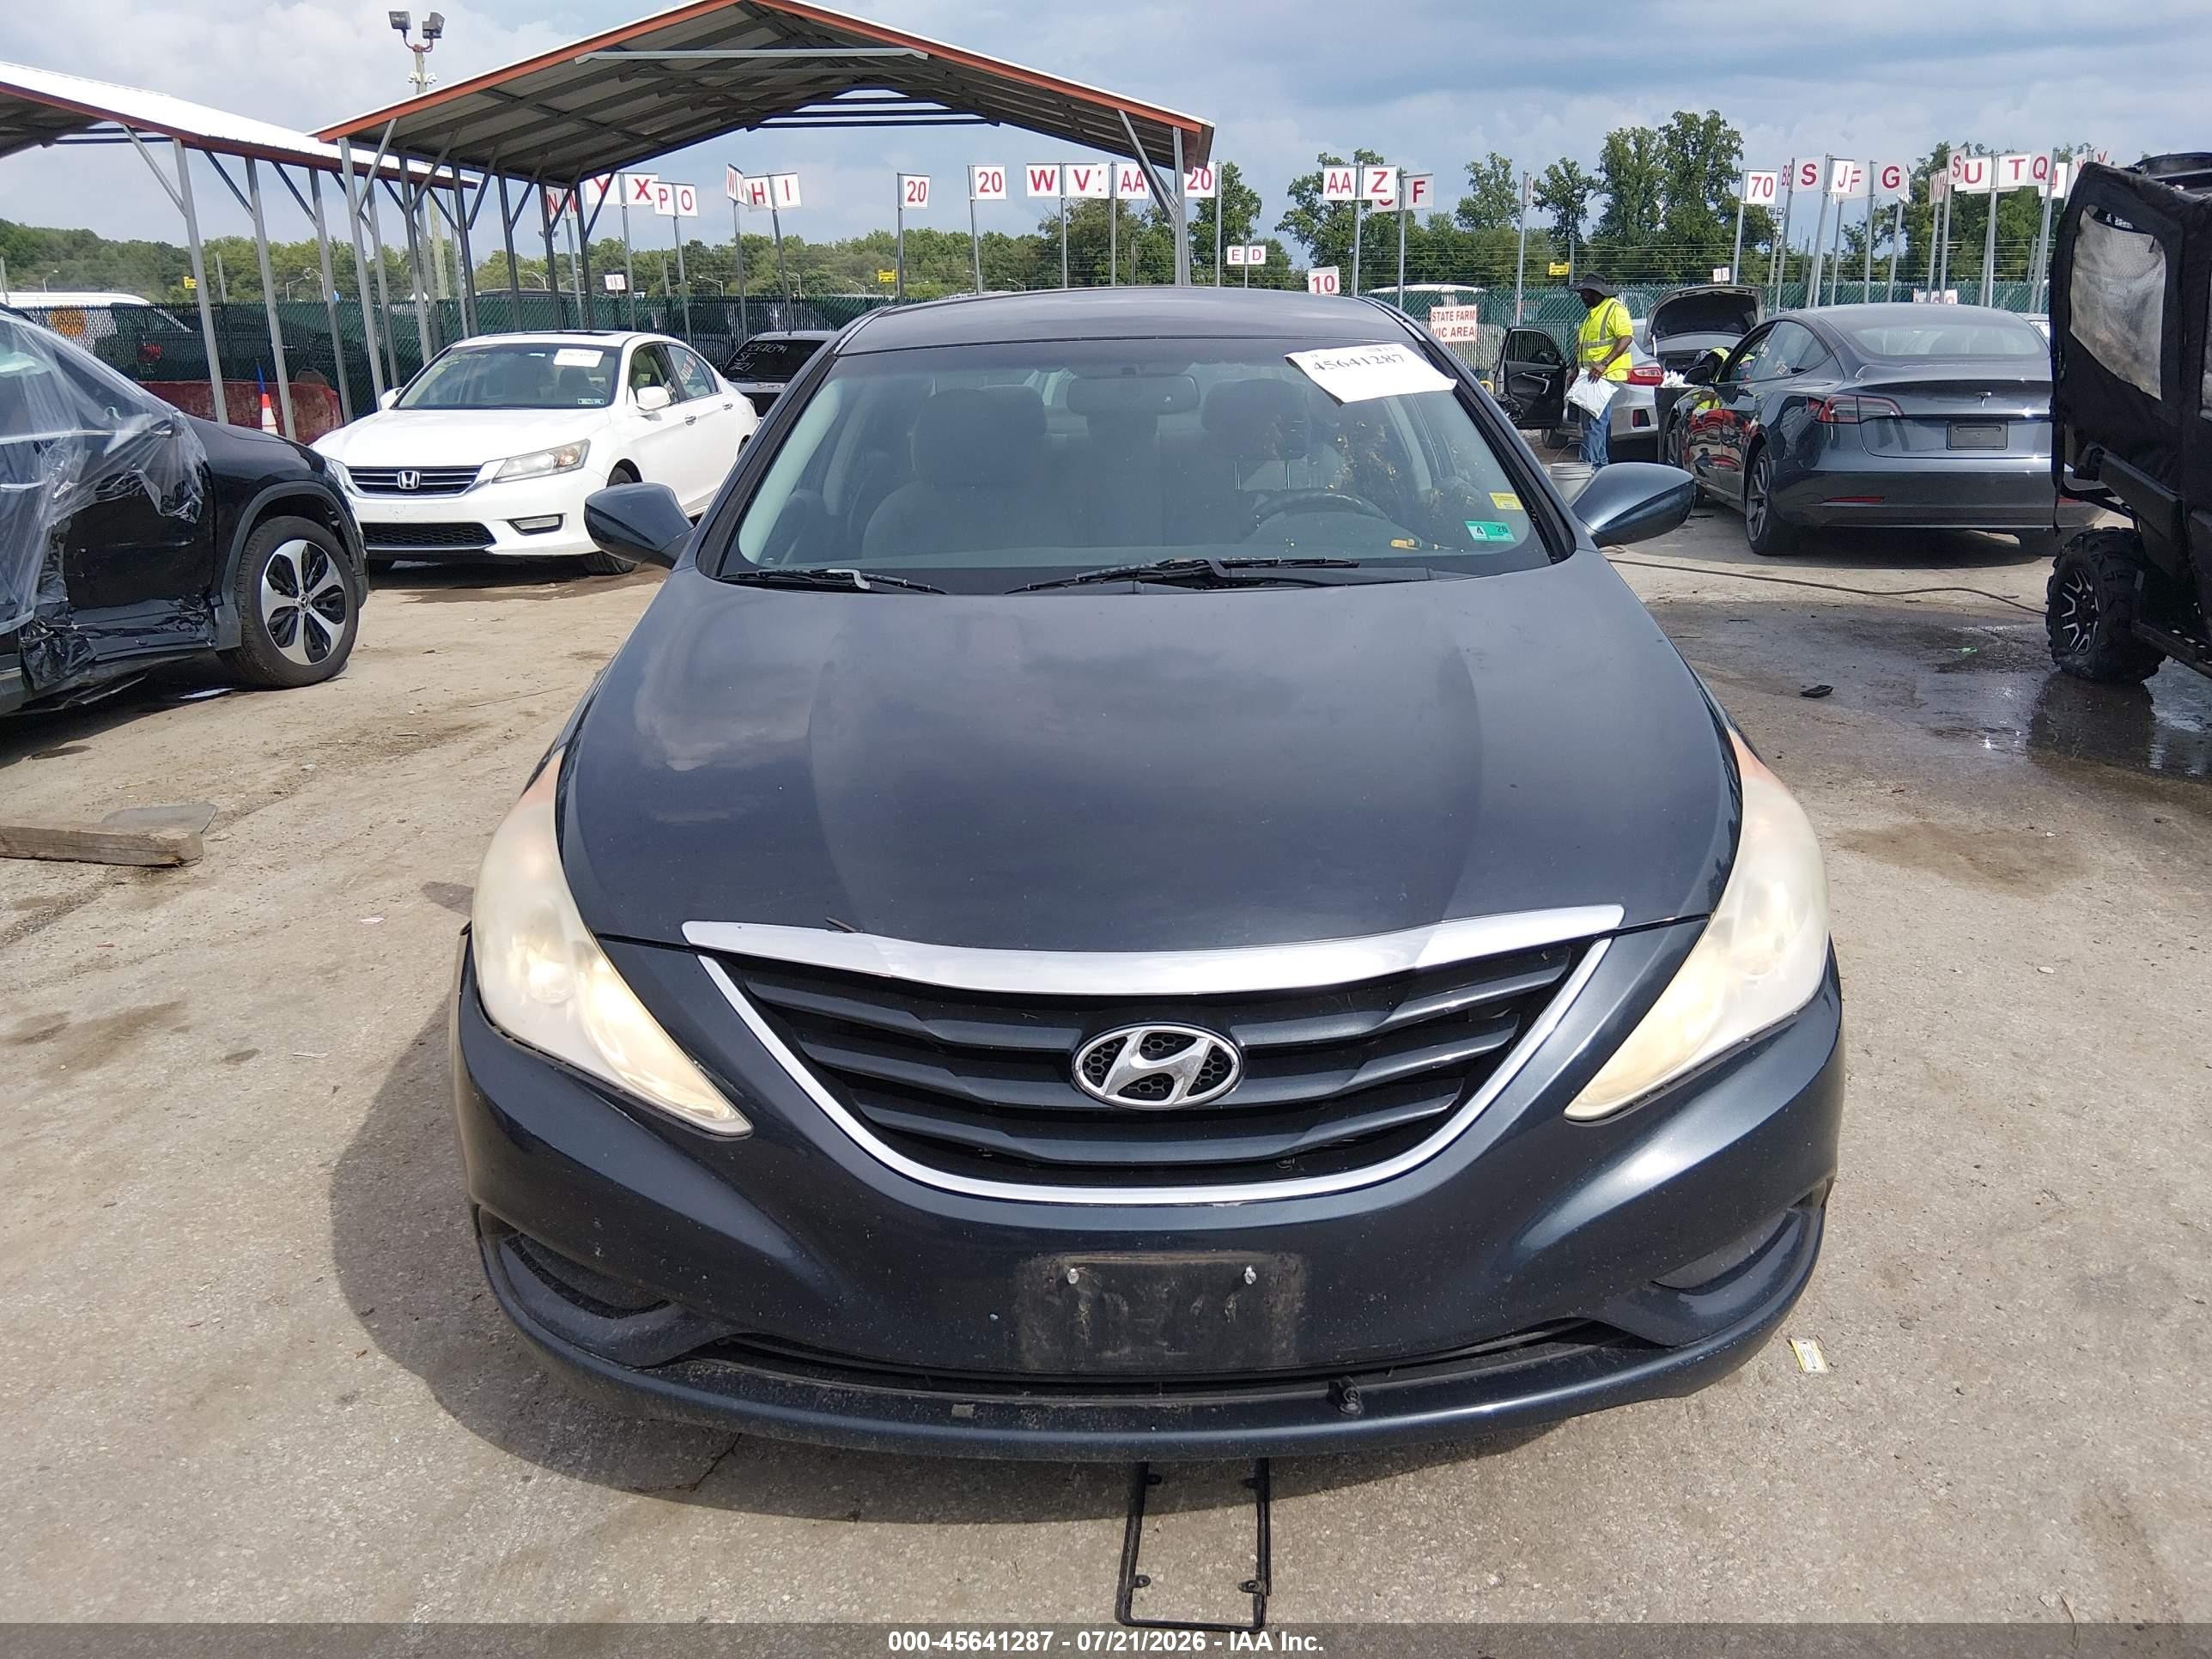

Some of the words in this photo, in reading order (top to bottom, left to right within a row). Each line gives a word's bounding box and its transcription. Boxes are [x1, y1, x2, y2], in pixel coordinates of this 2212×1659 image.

[1801, 163, 1818, 186] S
[1838, 165, 1849, 188] J
[1881, 165, 1900, 189] G
[1952, 155, 1961, 179] S
[1964, 161, 1983, 185] U
[2008, 158, 2027, 181] T
[2033, 155, 2049, 181] Q
[634, 178, 653, 201] X
[978, 171, 1003, 193] 20
[1030, 169, 1056, 192] W
[1073, 169, 1091, 191] V
[1121, 169, 1146, 193] AA
[1186, 167, 1213, 191] 20
[1327, 172, 1352, 194] AA
[1370, 171, 1389, 194] Z
[1750, 175, 1774, 199] 70
[659, 187, 669, 210] P
[751, 181, 767, 206] H
[784, 179, 792, 202] I
[906, 180, 927, 203] 20
[1413, 179, 1426, 204] F
[1231, 248, 1241, 262] E
[1252, 248, 1262, 262] D
[1311, 274, 1336, 295] 10
[1431, 310, 1454, 323] STATE
[1456, 309, 1475, 322] FARM
[1450, 325, 1475, 337] AREA
[1312, 353, 1406, 372] 45641287
